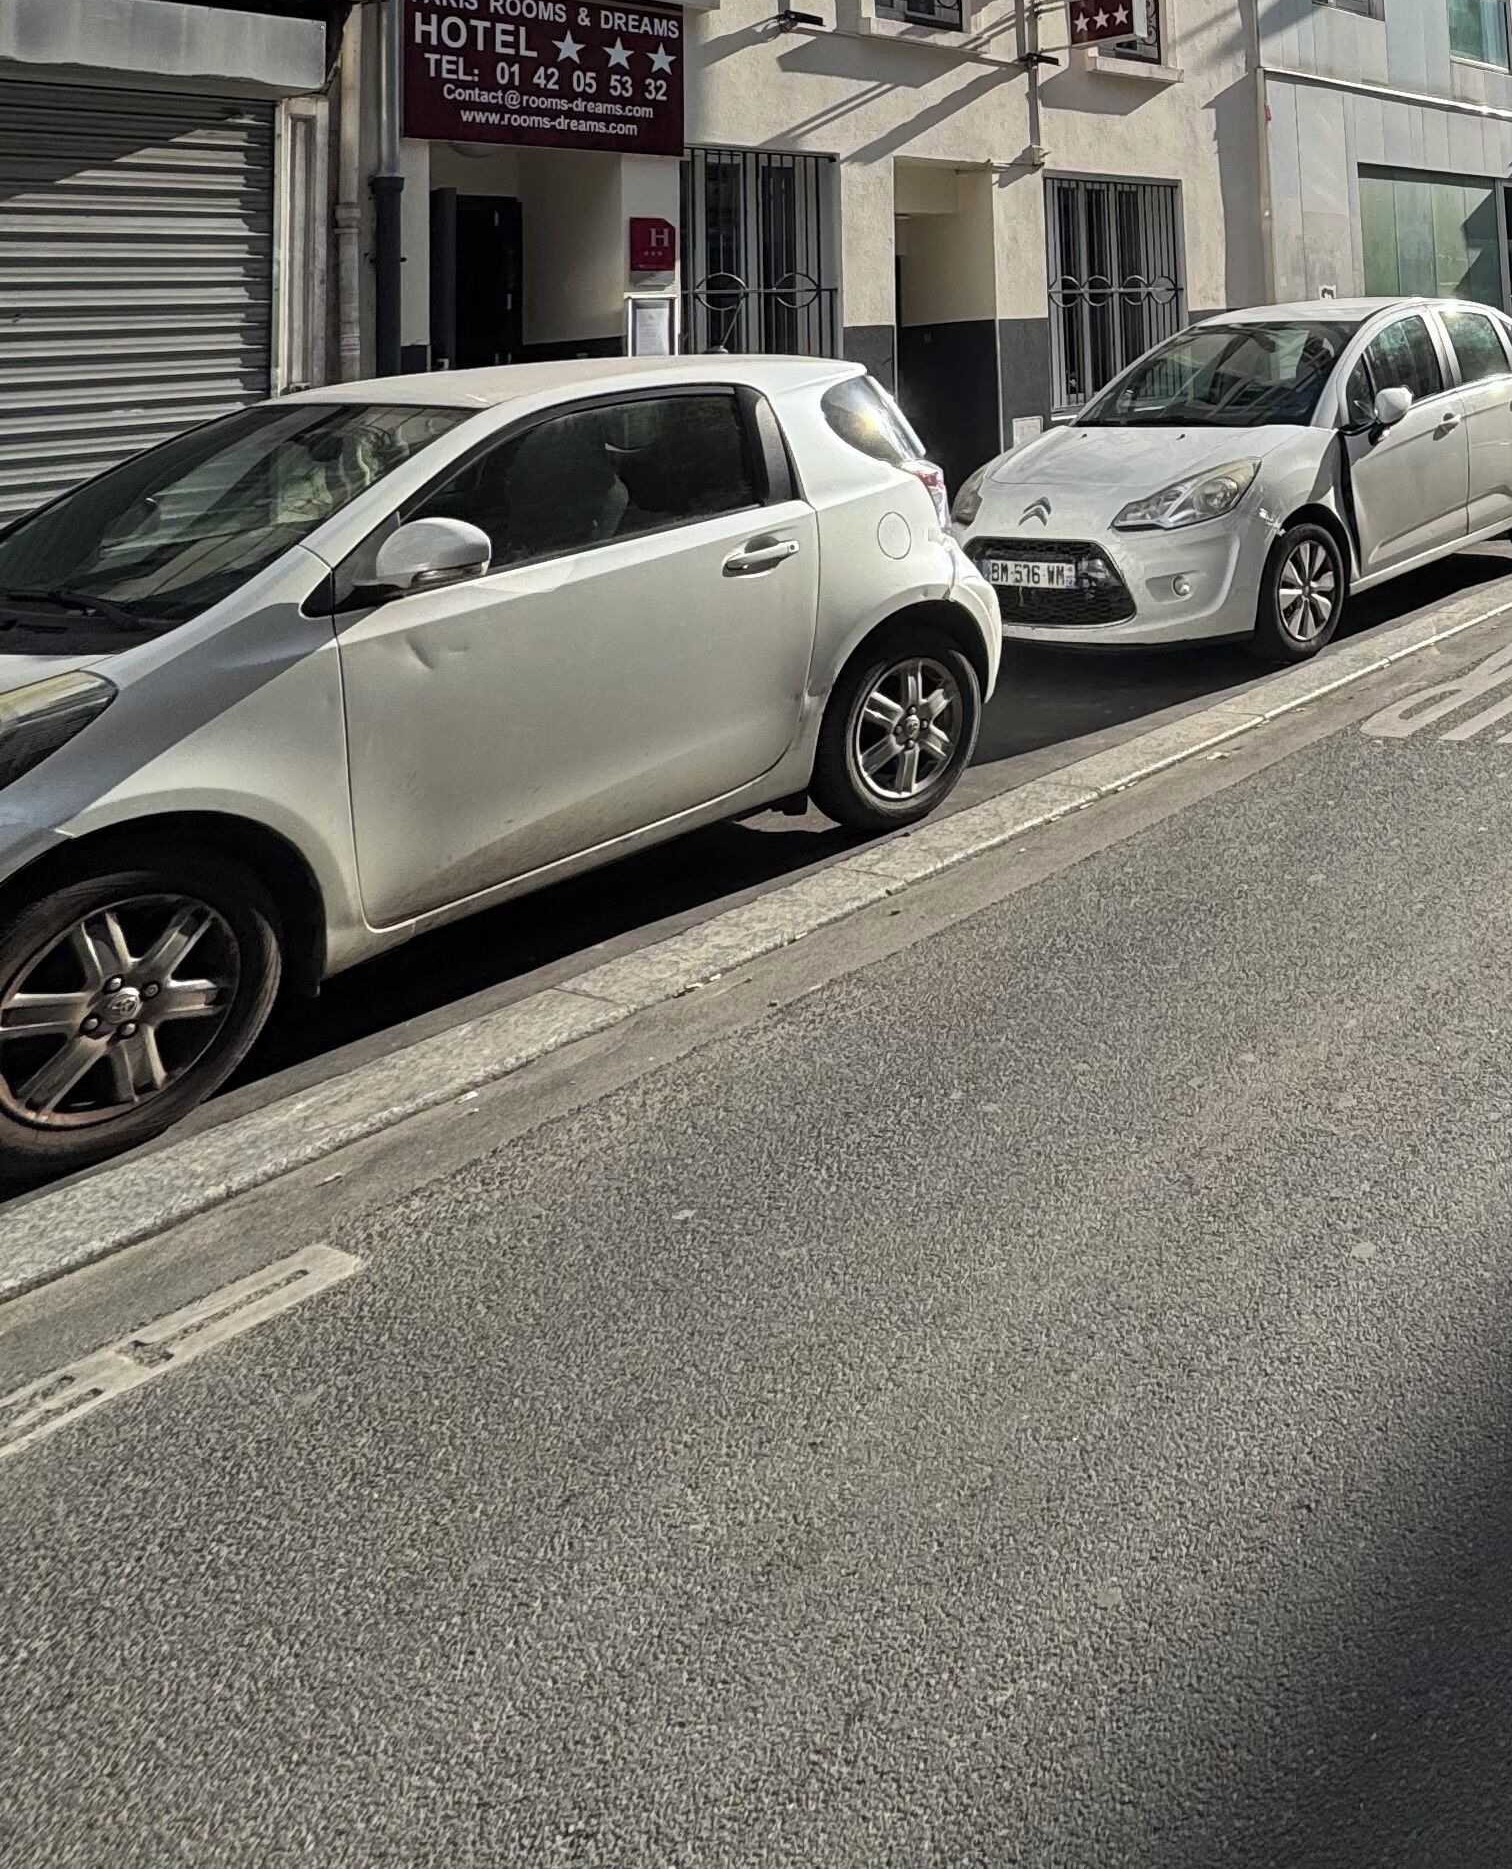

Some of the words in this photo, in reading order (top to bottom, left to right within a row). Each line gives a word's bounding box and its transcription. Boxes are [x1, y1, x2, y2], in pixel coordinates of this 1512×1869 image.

[414, 12, 538, 58] HOTEL
[577, 7, 591, 27] &
[601, 11, 679, 39] DREAMS
[424, 53, 479, 81] TEL:
[496, 62, 520, 86] 01
[533, 66, 559, 90] 42
[573, 70, 597, 94] 05
[609, 74, 632, 97] 53
[645, 78, 667, 101] 32
[443, 83, 653, 118] Contact@rooms-dreams.com
[460, 108, 638, 136] www.rooms-dreams.com
[650, 227, 669, 247] H
